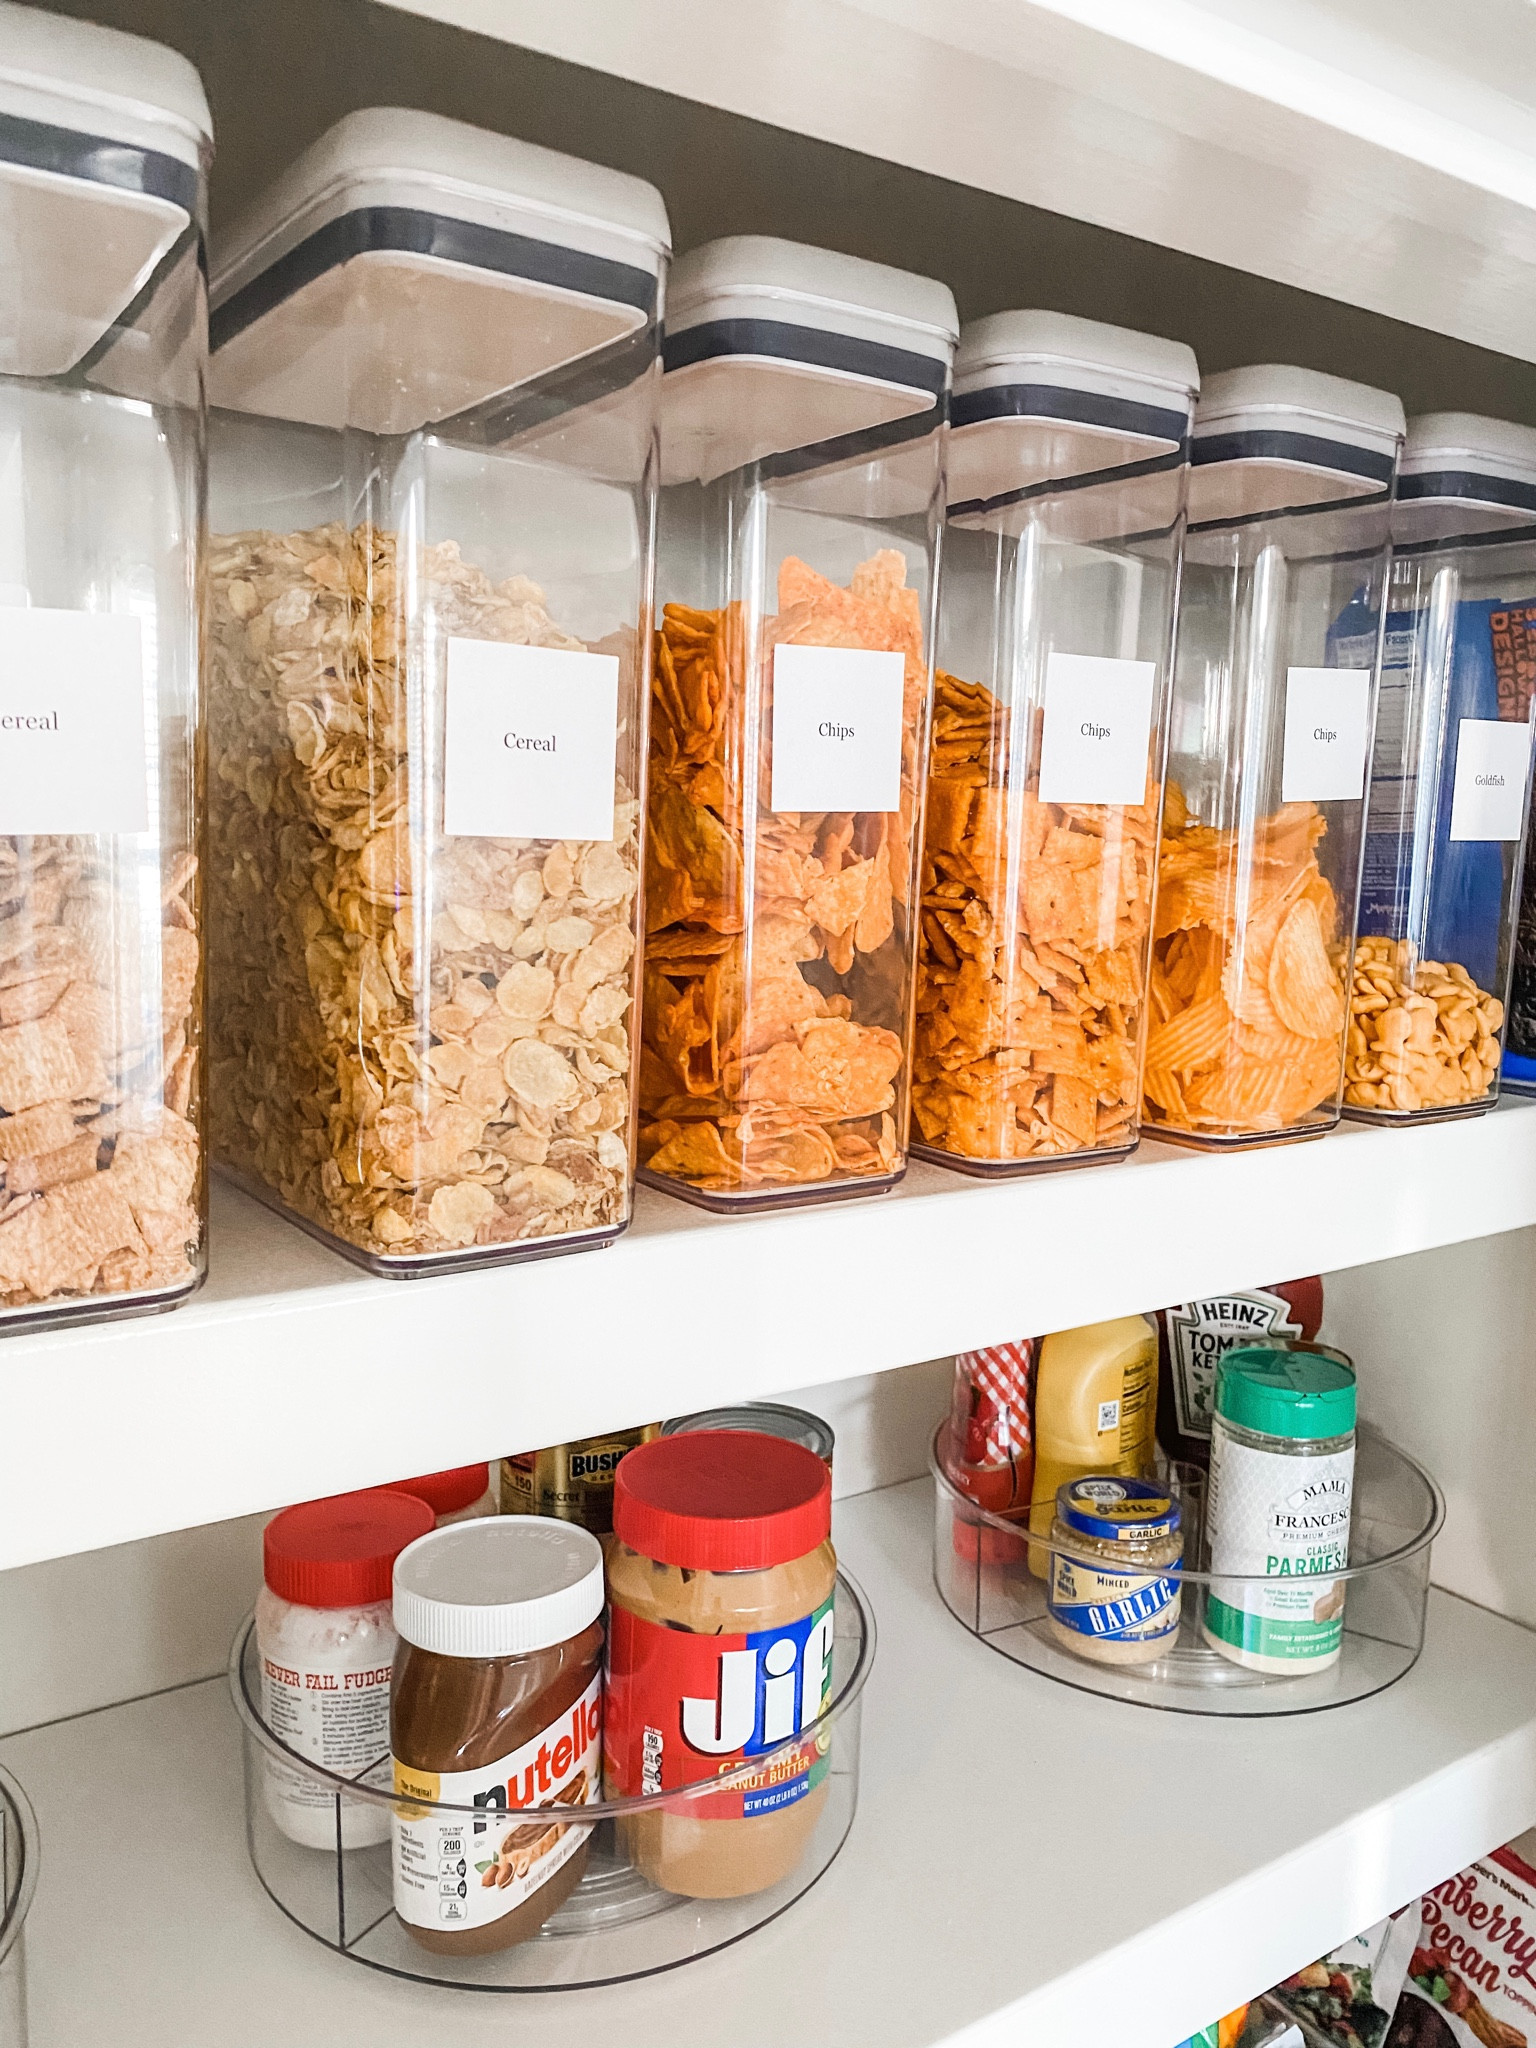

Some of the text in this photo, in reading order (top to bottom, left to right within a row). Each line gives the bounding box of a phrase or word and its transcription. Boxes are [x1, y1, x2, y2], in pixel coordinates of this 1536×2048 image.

[1, 710, 59, 731] ereal
[818, 721, 855, 741] Chips
[1080, 722, 1111, 741] Chips
[1313, 727, 1337, 742] Chips
[504, 732, 556, 752] Cereal
[1475, 774, 1505, 787] Goldfish
[1201, 1302, 1269, 1328] HEINZ
[515, 1475, 532, 1492] 150
[1304, 1480, 1346, 1501] MAMA
[1274, 1506, 1350, 1529] FRANCESC
[1129, 1528, 1162, 1538] GARLIC
[1283, 1532, 1324, 1540] PREMIUM
[1306, 1541, 1339, 1556] CLASSIC
[1266, 1547, 1347, 1577] PARMESA
[1088, 1577, 1173, 1633] GARLIC
[305, 1673, 338, 1691] FAIL
[681, 1608, 834, 1754] Jif
[648, 1734, 657, 1745] 190
[769, 1756, 810, 1784] BUTTER
[410, 1784, 432, 1797] Original
[744, 1801, 753, 1810] NET
[754, 1799, 762, 1809] WT
[444, 1840, 460, 1850] 200
